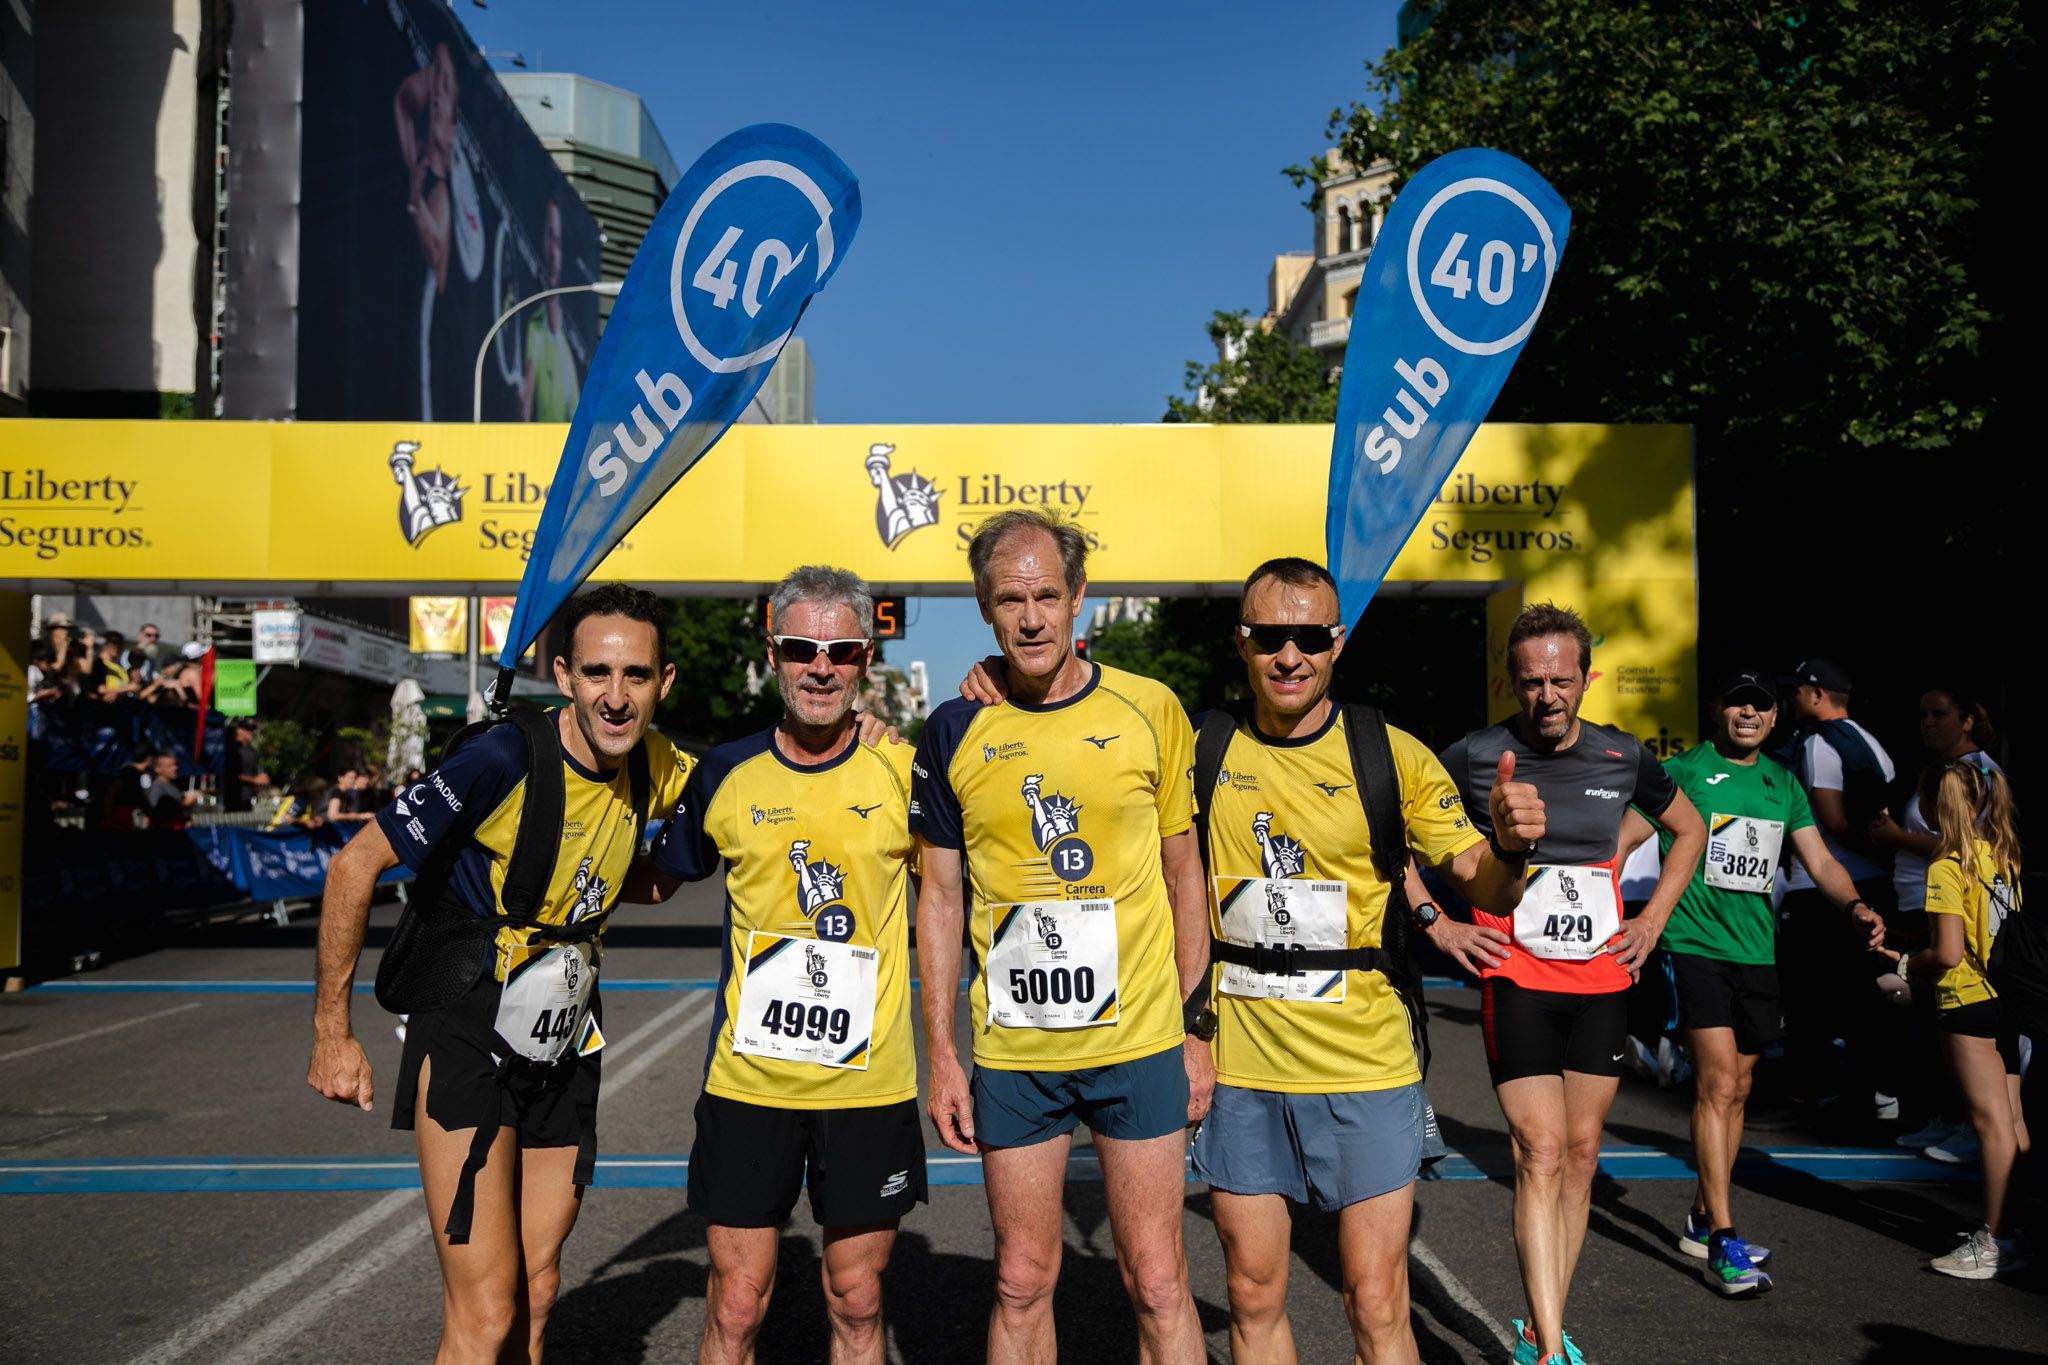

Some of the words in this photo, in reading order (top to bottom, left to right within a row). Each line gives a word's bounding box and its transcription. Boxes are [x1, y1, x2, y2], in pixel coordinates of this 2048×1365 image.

[1364, 358, 1449, 475] sub
[588, 369, 692, 497] sub
[2, 469, 138, 514] Liberty
[958, 474, 1092, 517] Liberty
[999, 741, 1025, 751] Liberty
[1231, 772, 1257, 782] Liberty
[433, 775, 463, 812] MADRID
[767, 807, 794, 816] Liberty
[1059, 849, 1085, 870] 13
[1722, 853, 1770, 880] 3824
[1065, 884, 1106, 894] Carrera
[824, 915, 848, 936] 13
[1278, 914, 1288, 923] 13
[1543, 914, 1593, 943] 429
[1049, 936, 1059, 946] 13
[815, 974, 825, 984] 13
[1009, 966, 1095, 1005] 5000
[530, 1004, 578, 1045] 443
[761, 999, 850, 1045] 4999
